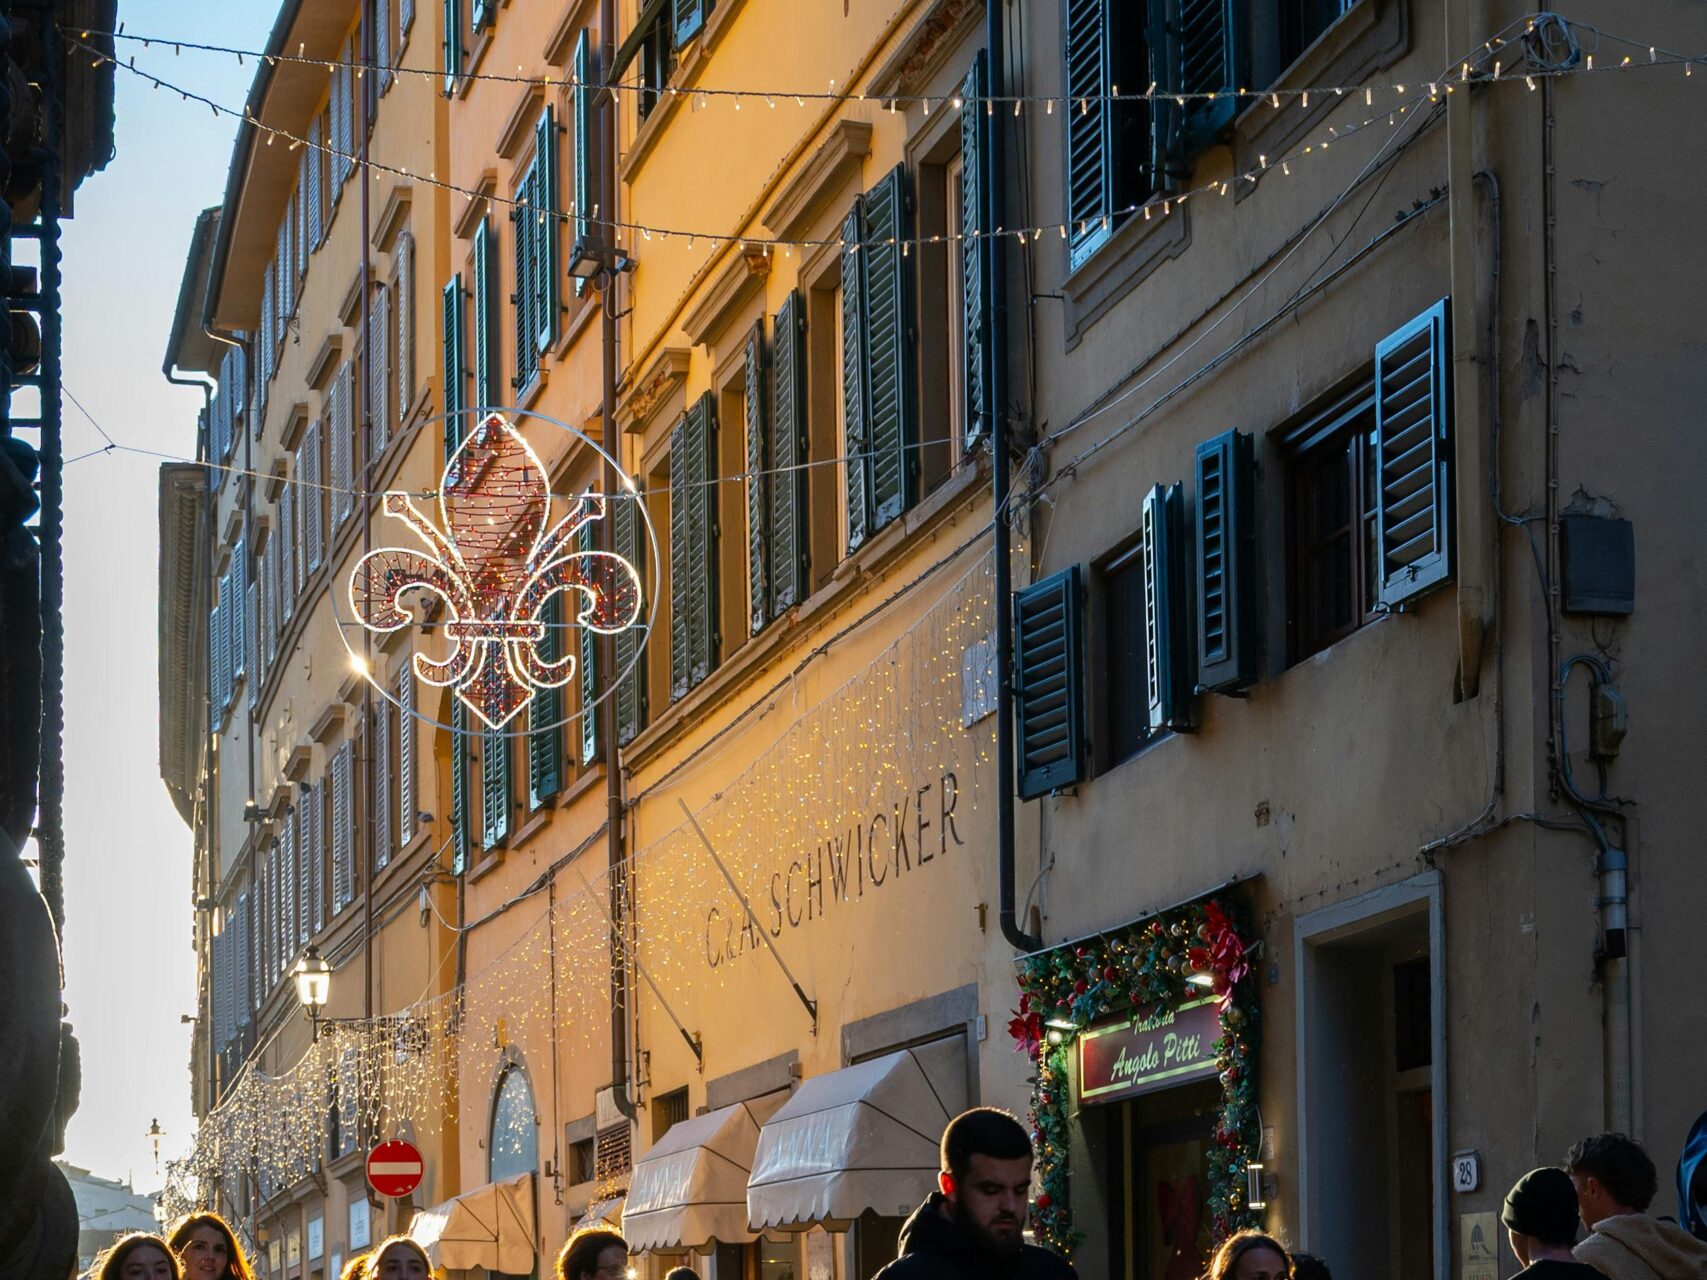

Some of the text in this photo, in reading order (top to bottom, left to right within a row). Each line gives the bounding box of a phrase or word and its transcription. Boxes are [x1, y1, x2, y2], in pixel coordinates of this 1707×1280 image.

[770, 772, 965, 938] SCHWICKER
[1111, 1032, 1200, 1084] Angolo Pitti
[1460, 1161, 1472, 1185] 28
